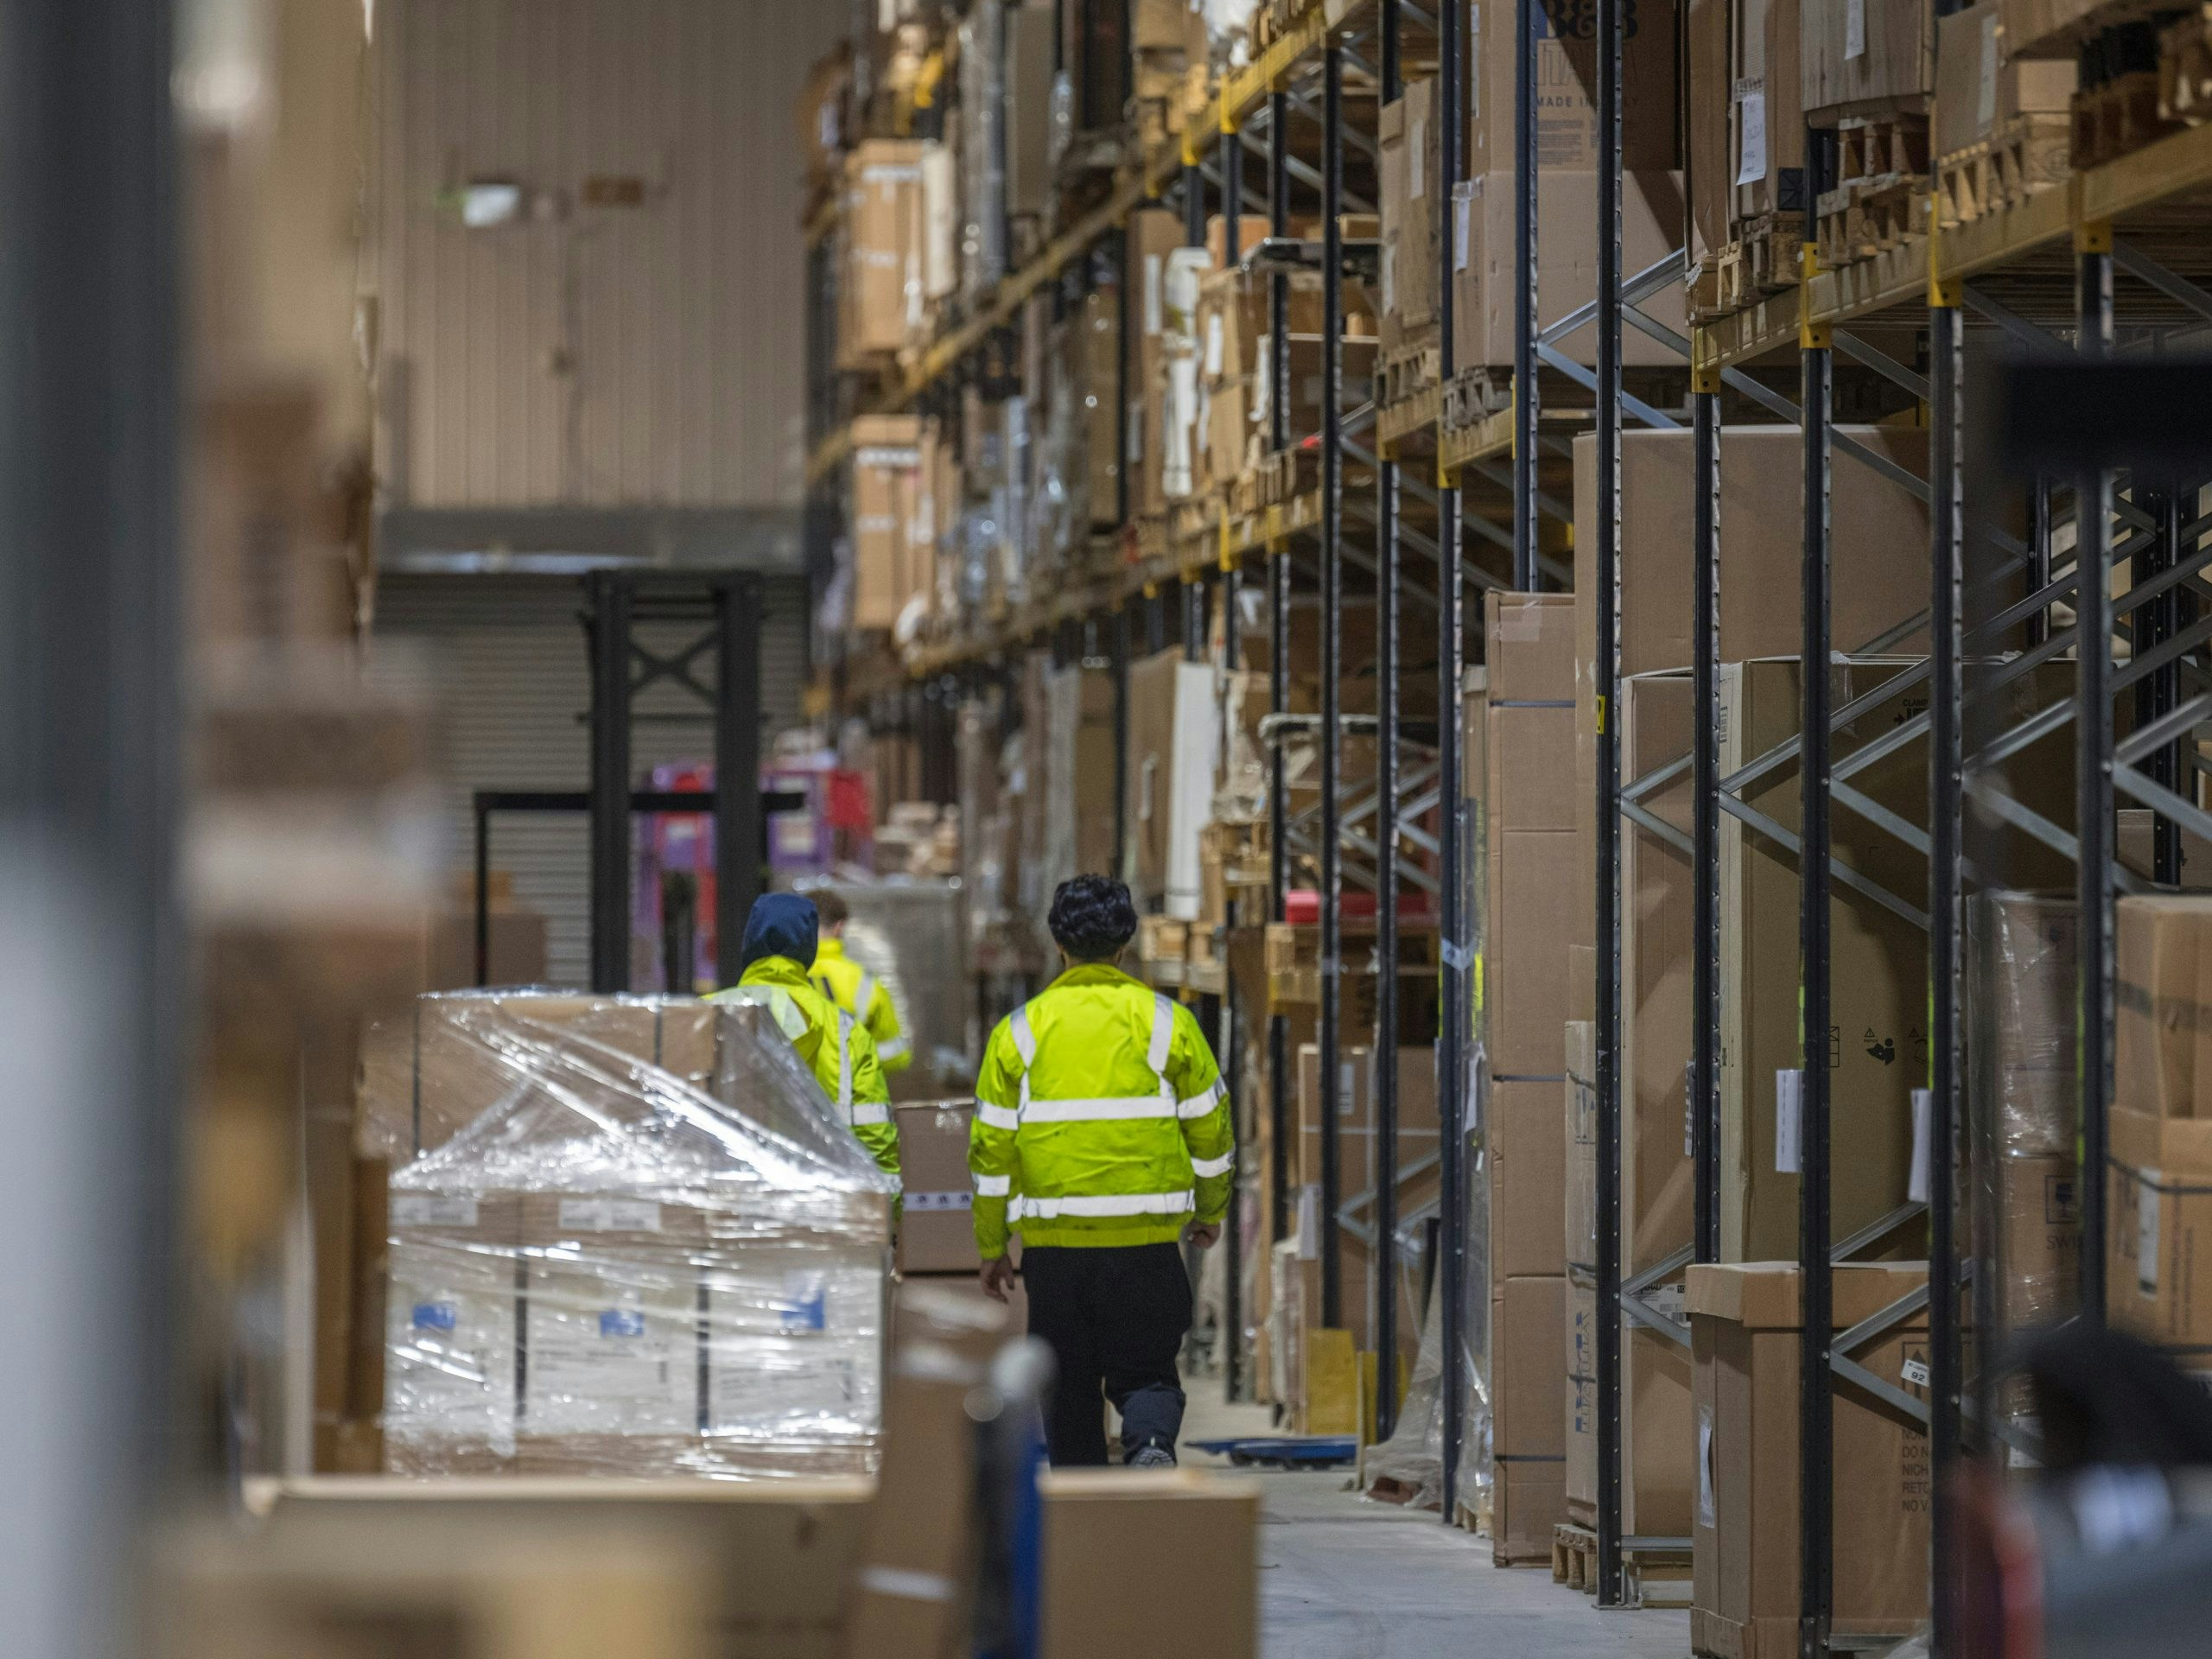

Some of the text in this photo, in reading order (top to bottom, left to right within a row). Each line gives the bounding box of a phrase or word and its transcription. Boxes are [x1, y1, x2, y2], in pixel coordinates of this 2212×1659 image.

[1537, 95, 1573, 107] MADE
[1903, 698, 1929, 707] CLAMP
[1911, 1371, 1925, 1382] 92
[1902, 1446, 1918, 1458] DO
[1902, 1465, 1929, 1476] NICH
[1902, 1500, 1918, 1512] NO
